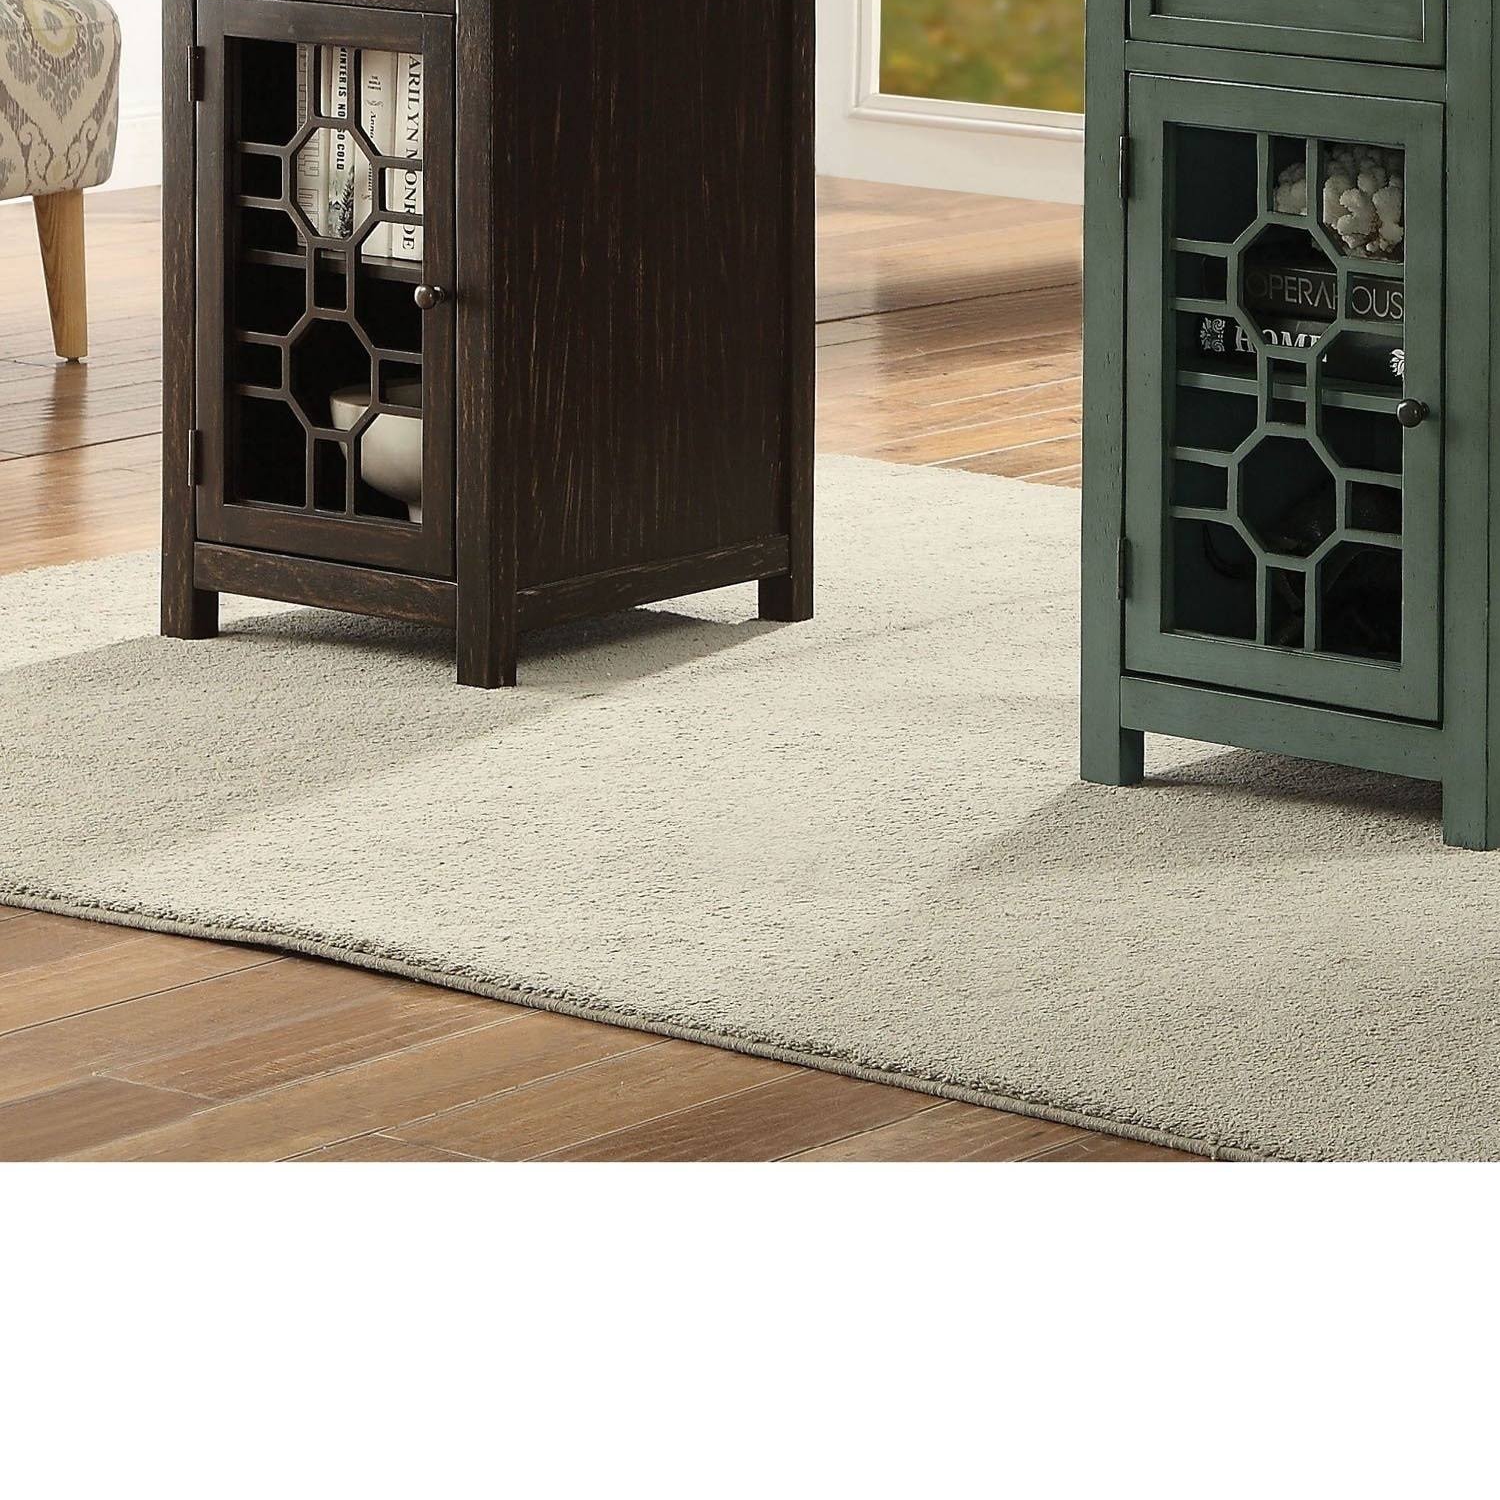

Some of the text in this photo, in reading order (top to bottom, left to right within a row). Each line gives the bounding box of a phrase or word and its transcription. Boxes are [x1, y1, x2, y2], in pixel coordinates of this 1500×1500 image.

[338, 86, 347, 97] IS
[406, 55, 421, 143] ARILYN
[337, 103, 346, 117] NO
[336, 143, 345, 171] COLD
